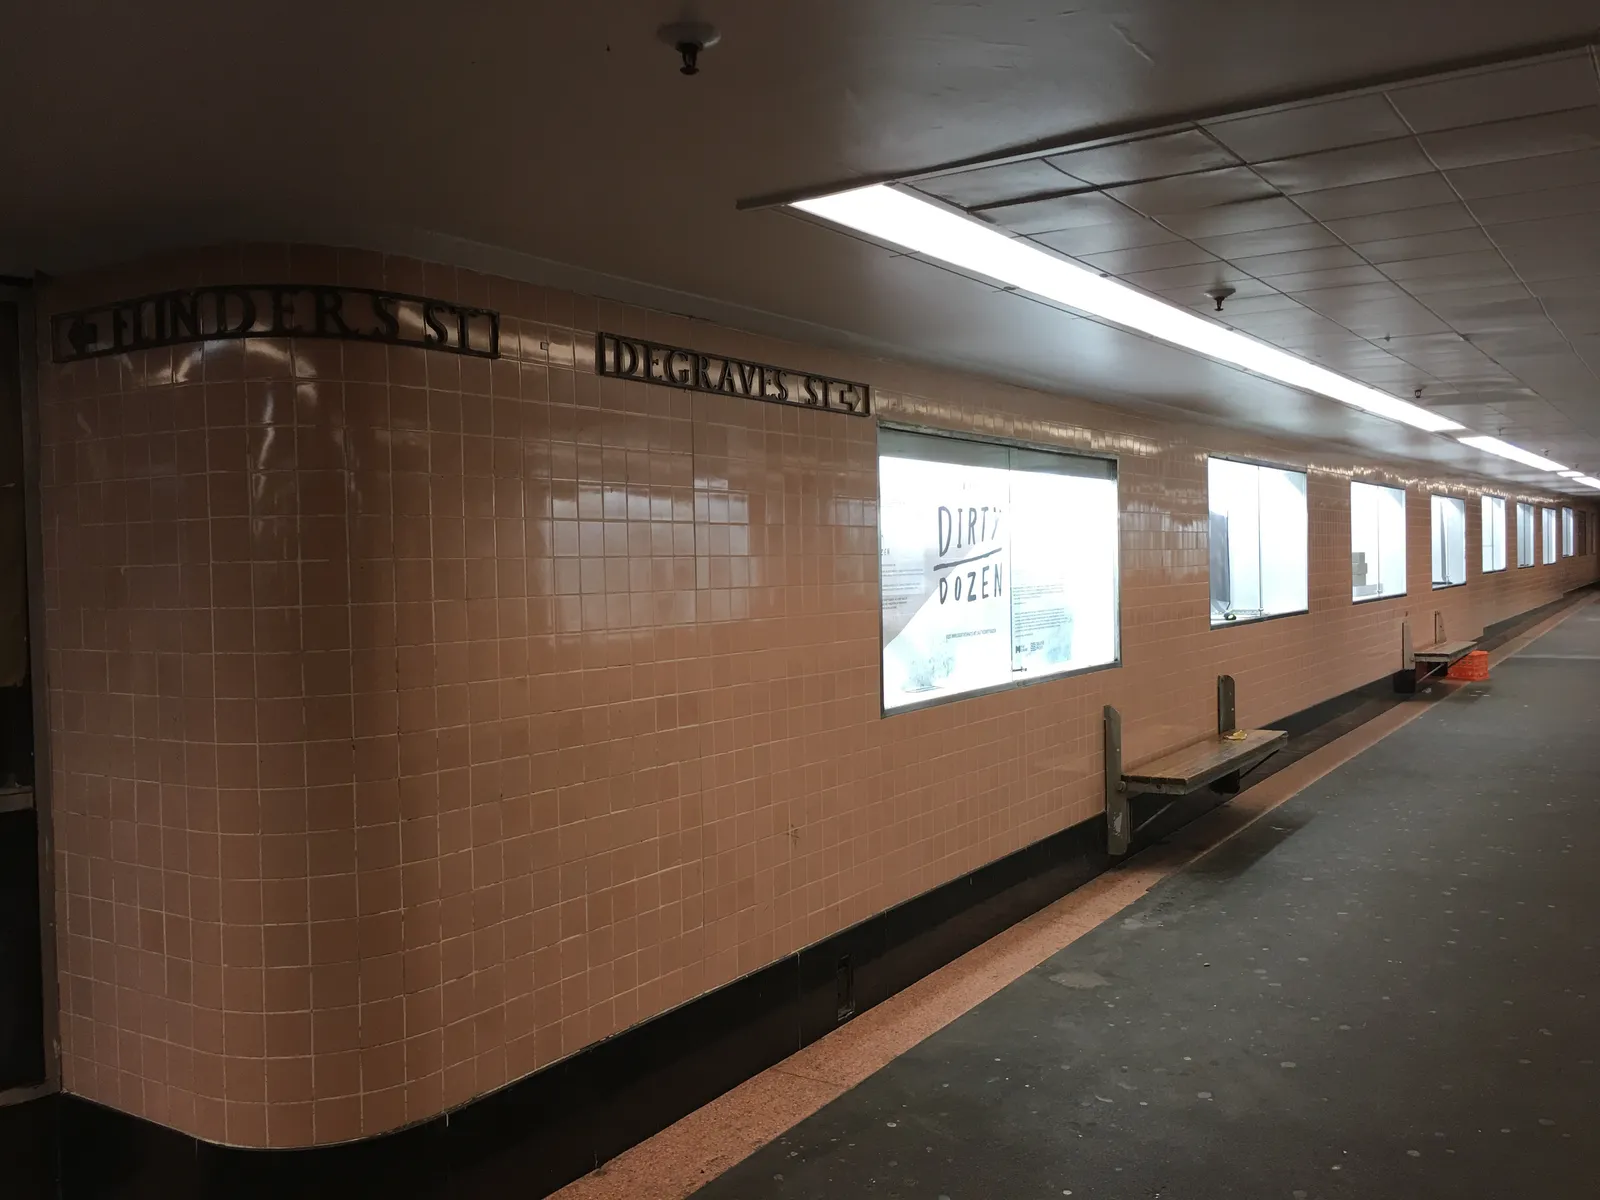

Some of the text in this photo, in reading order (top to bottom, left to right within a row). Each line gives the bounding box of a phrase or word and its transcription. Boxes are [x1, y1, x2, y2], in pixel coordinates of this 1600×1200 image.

[112, 286, 477, 351] FLINDERS ST
[613, 338, 834, 407] DEGRAVES ST
[938, 505, 1002, 557] DIRTY
[938, 562, 1003, 605] DOZEN
